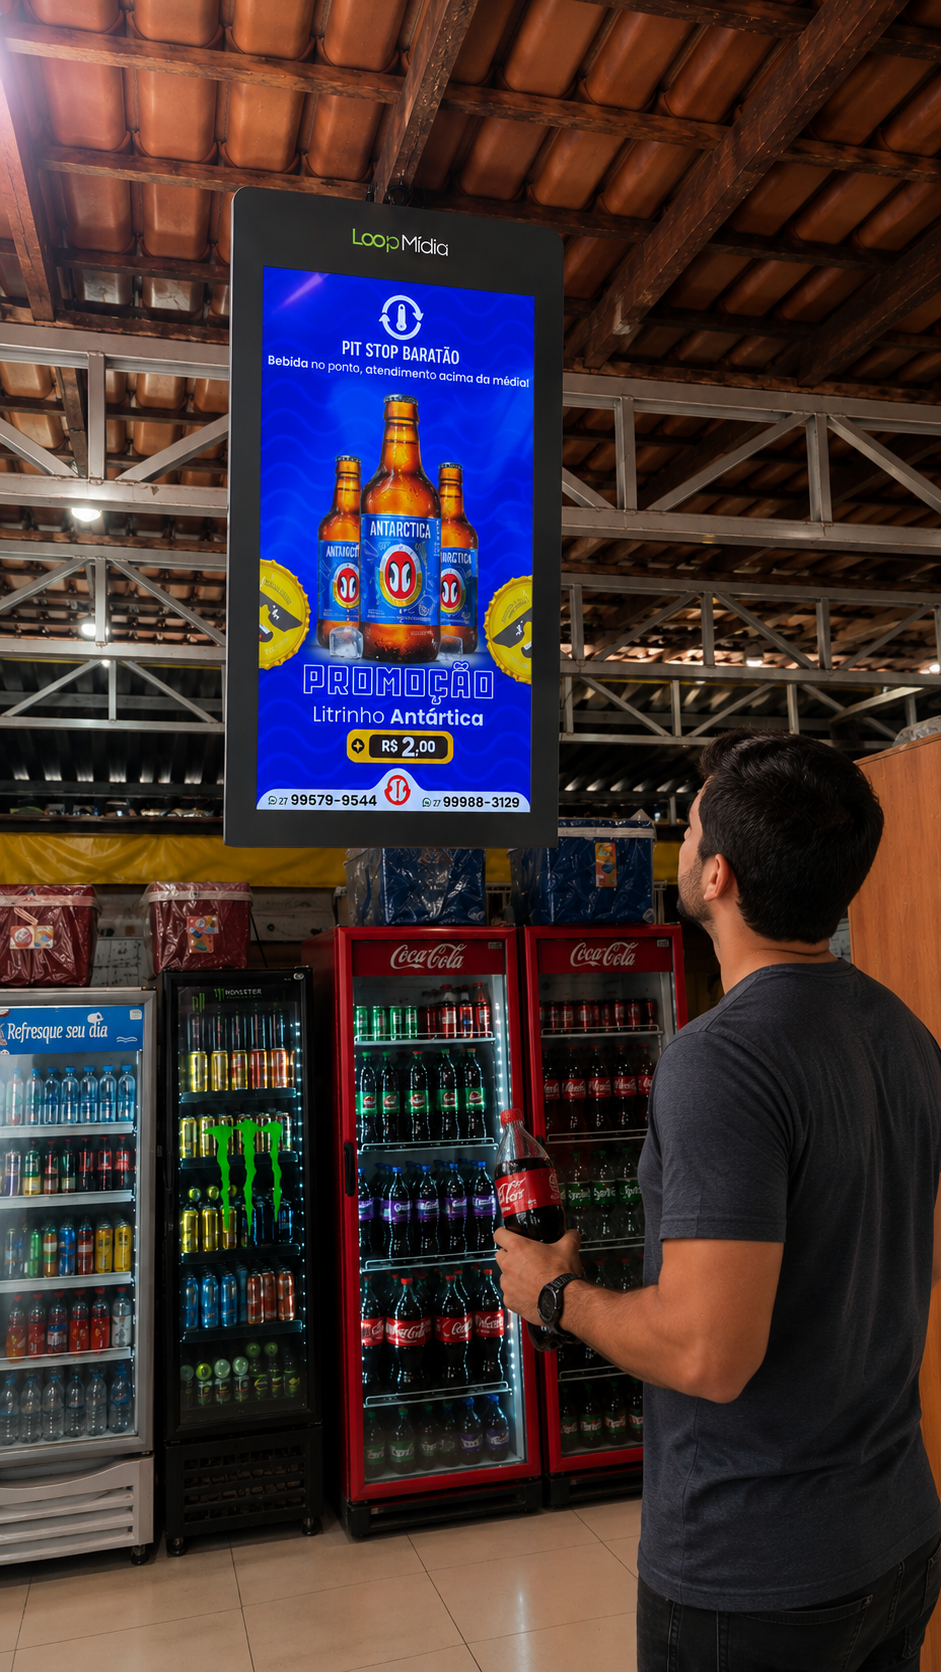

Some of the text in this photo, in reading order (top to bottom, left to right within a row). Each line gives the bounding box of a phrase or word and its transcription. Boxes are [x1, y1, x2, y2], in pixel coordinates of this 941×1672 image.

[342, 340, 460, 365] PIT STOP BARATÃO
[267, 355, 308, 369] Bebida
[311, 361, 326, 370] no
[328, 361, 364, 375] ponto,
[365, 364, 437, 381] atendimento
[438, 371, 474, 384] acima
[475, 373, 491, 385] da
[370, 520, 432, 540] ANTARCTICA
[303, 661, 495, 705] PROMOÇÃO
[313, 706, 484, 726] Litrinho Antártica
[381, 739, 399, 753] R$
[291, 793, 377, 807] 99579-9544
[443, 795, 520, 809] 99988-3129
[7, 1020, 109, 1044] Refresque seu dia
